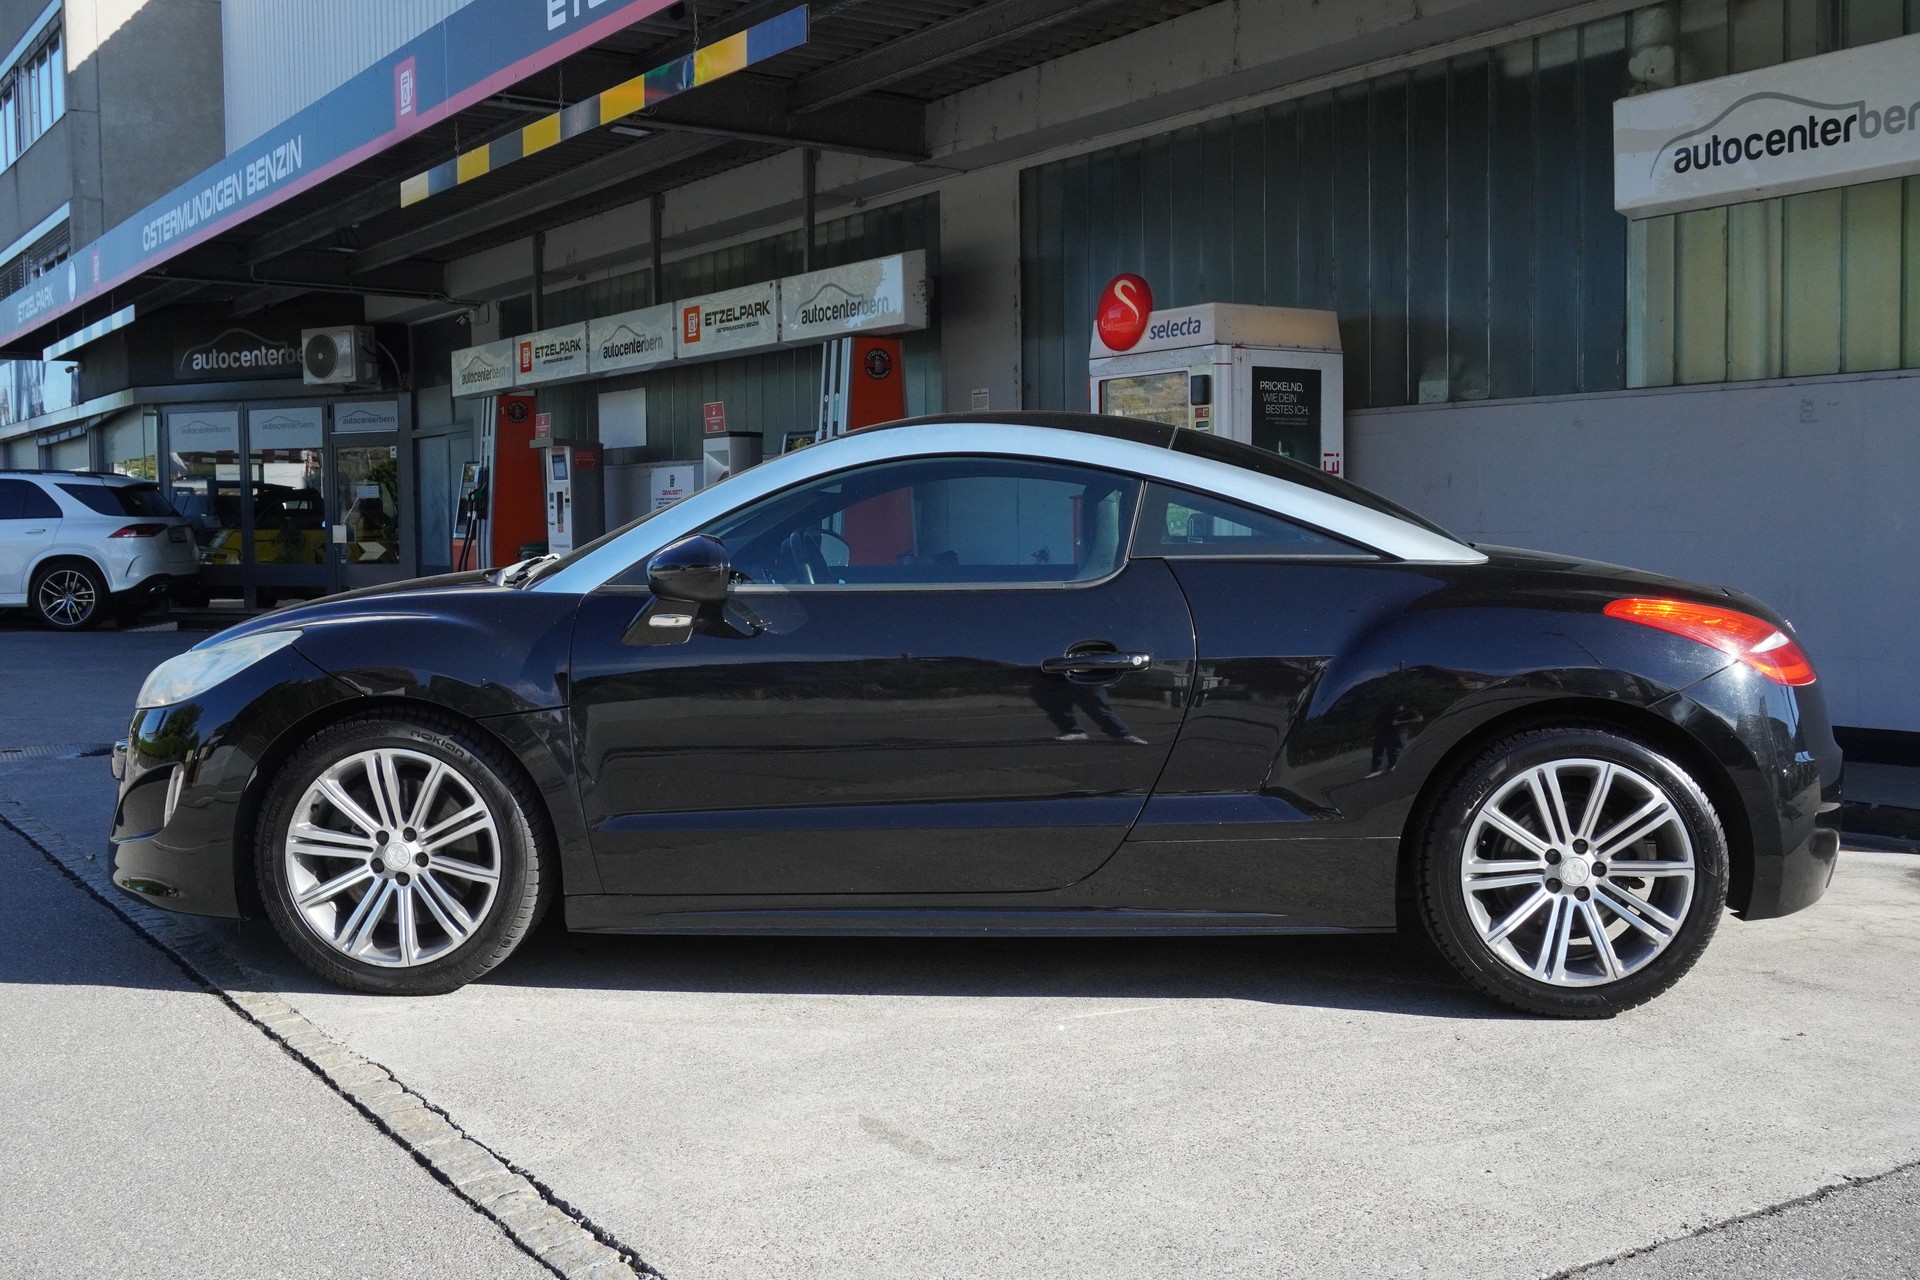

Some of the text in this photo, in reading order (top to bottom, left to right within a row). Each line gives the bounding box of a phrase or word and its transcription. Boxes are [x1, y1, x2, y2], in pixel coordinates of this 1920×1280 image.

[142, 134, 302, 252] OSTERMUNDIGEN BENZIN
[17, 282, 55, 324] ETZELPARK
[704, 299, 771, 327] ETZELPARK
[801, 296, 889, 325] autocenterbern
[1149, 316, 1202, 340] selecta
[534, 338, 582, 359] ETZELPARK
[602, 334, 664, 360] autocenterbern
[461, 364, 506, 386] autocenterbern
[1260, 380, 1304, 393] PRICKELND,
[1262, 392, 1297, 403] WIE DEIN
[342, 415, 396, 425] autocenterbern
[1265, 404, 1310, 415] BESTES ICH.
[180, 425, 231, 436] autocenterbern
[261, 421, 314, 431] autocenterbern
